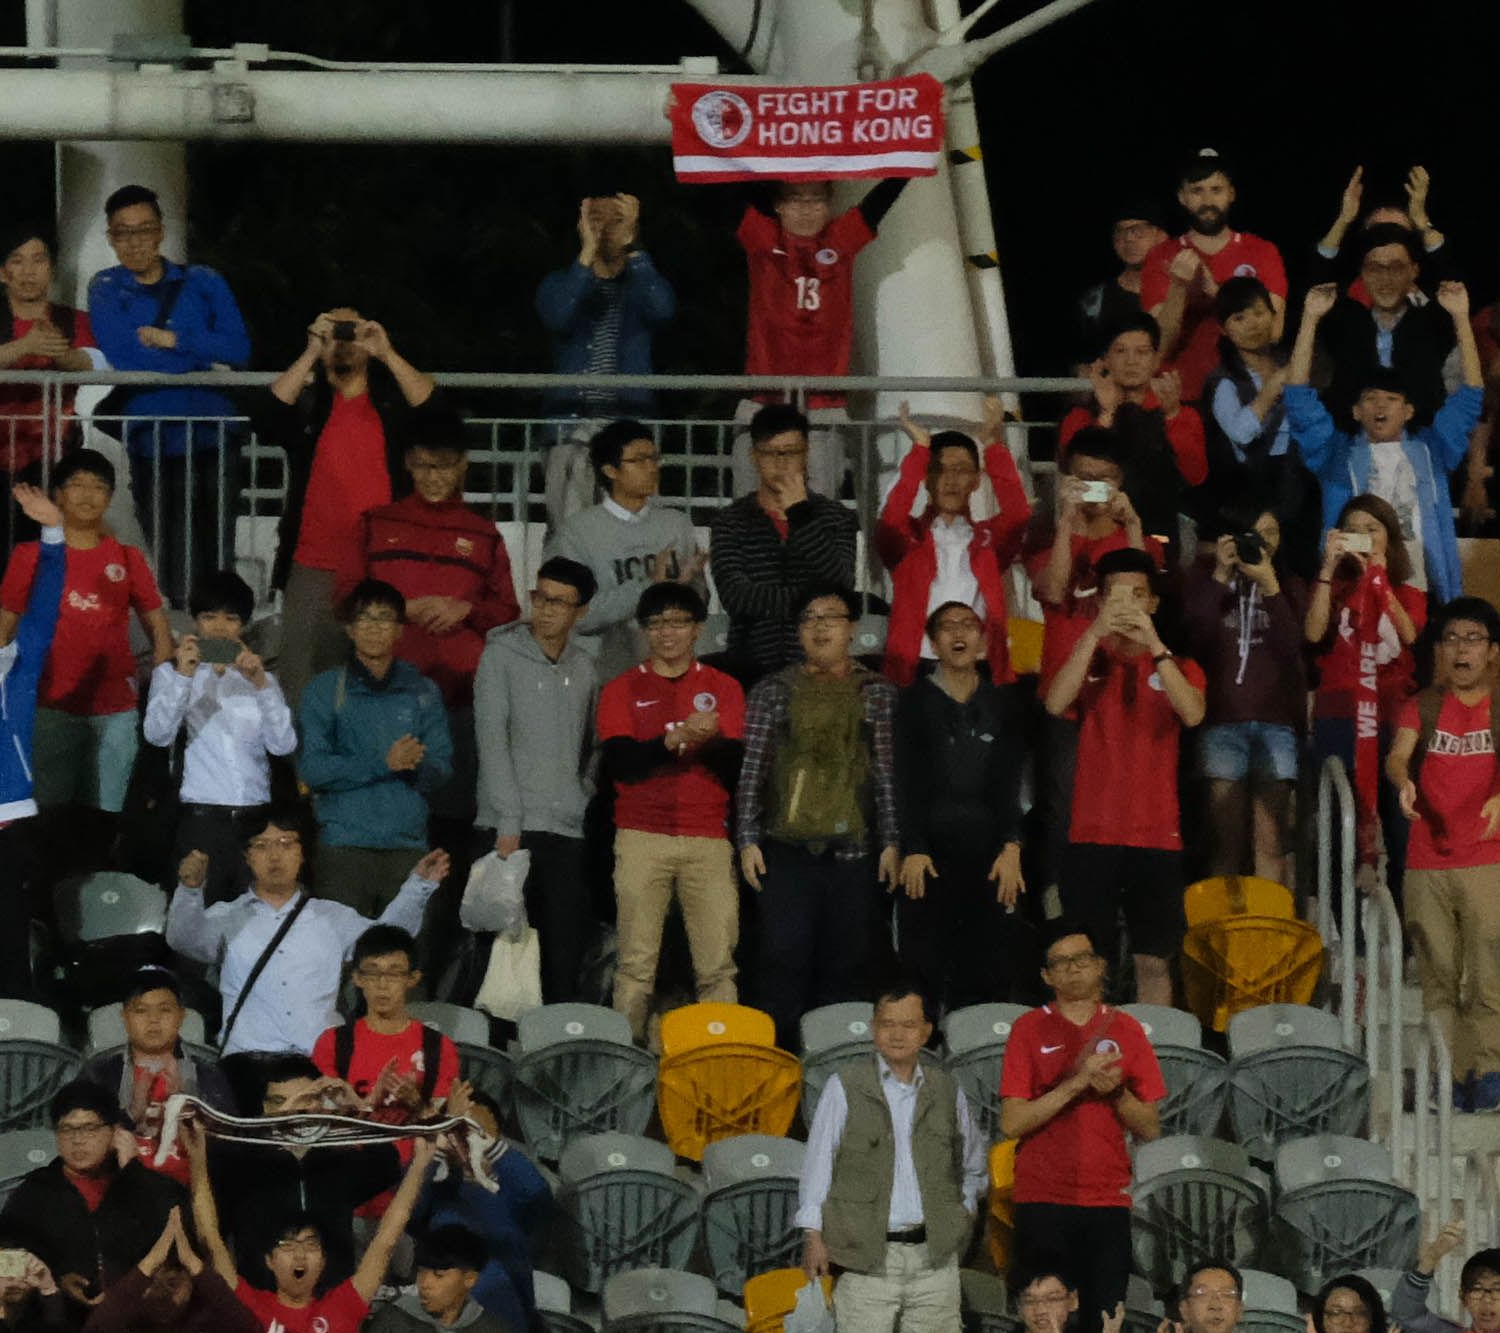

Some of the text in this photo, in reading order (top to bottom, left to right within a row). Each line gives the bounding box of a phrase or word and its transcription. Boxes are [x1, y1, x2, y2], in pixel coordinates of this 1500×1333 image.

[757, 85, 919, 119] FIGHT FOR
[757, 113, 933, 148] HONG KONG
[795, 276, 821, 310] 13
[1357, 640, 1378, 738] WE ARE
